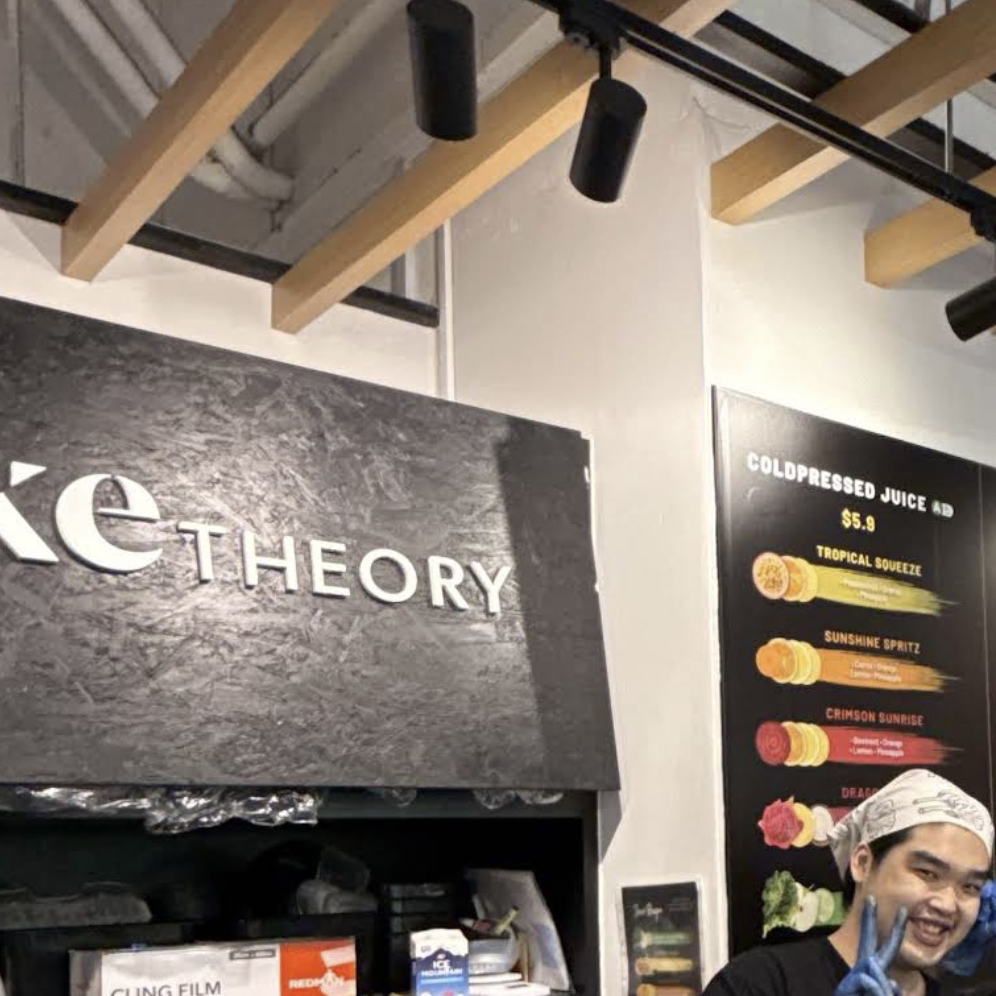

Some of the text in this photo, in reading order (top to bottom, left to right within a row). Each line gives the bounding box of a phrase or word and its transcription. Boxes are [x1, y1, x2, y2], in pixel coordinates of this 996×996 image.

[747, 452, 875, 499] COLDPRESSED
[880, 486, 927, 512] JUICE
[842, 508, 875, 532] $5.9
[177, 521, 515, 614] THEORY
[816, 545, 922, 577] TROPICAL SQUEEZE
[824, 630, 921, 655] SUNSHINE SPRITZ
[826, 708, 924, 726] CRIMSON SUNRISE
[432, 960, 450, 969] ICE
